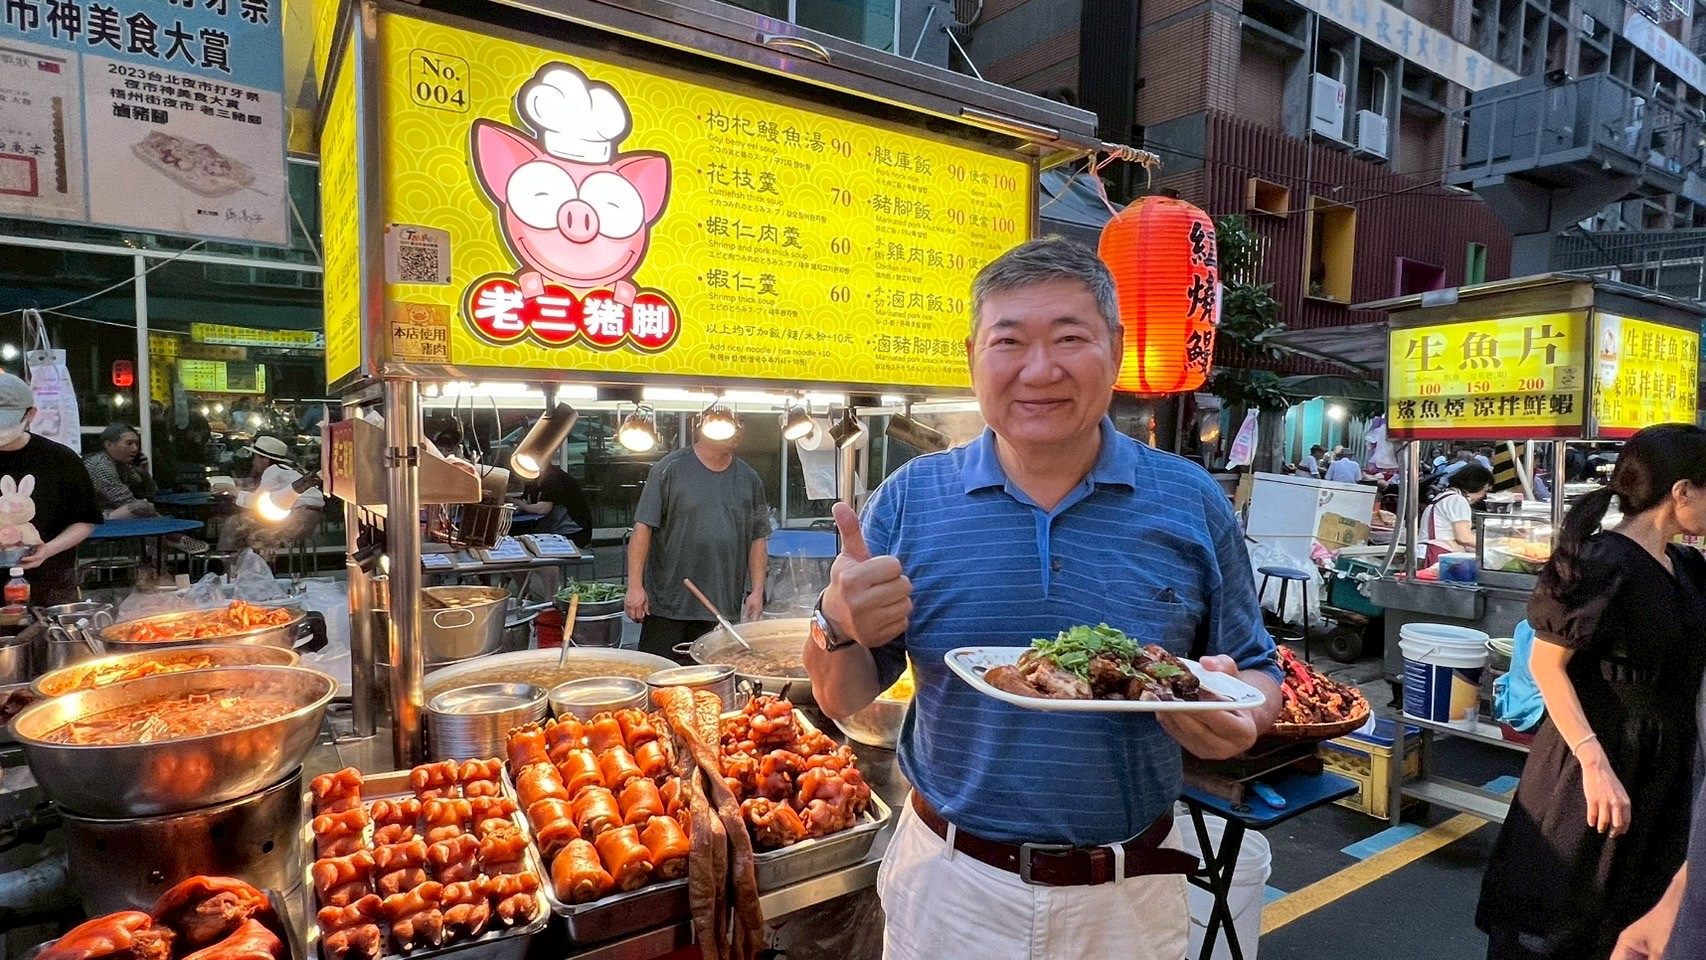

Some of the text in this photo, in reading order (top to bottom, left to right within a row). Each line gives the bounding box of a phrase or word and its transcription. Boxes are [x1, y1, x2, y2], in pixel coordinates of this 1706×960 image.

[4, 0, 231, 73] 市神美食大賞
[421, 56, 460, 81] No.
[417, 81, 465, 107] 004
[705, 108, 851, 158] 枸杞鰻魚湯 90
[708, 134, 723, 144] Goji
[725, 137, 745, 149] berry
[760, 145, 777, 155] soup
[873, 146, 932, 177] 腿庫飯
[948, 164, 965, 182] 90
[993, 174, 1016, 192] 100
[706, 162, 851, 207] 花枝羹 70
[708, 187, 745, 200] Cuttlefish
[766, 196, 784, 206] soup
[872, 193, 932, 222] 豬腳飯
[948, 208, 965, 226] 90
[991, 216, 1015, 234] 100
[706, 216, 851, 255] 蝦仁肉羹 60
[708, 240, 808, 261] Shrimp and pork thick soup
[887, 242, 945, 269] 雞肉飯
[947, 254, 964, 271] 30
[706, 268, 851, 303] 蝦仁羹 60
[708, 292, 775, 307] Shrimp thick soup
[887, 289, 964, 314] 滷肉飯 30
[394, 327, 446, 341] 本店使用
[709, 343, 726, 351] Add
[873, 333, 967, 357] 滷豬腳麵線
[1404, 324, 1566, 373] 生魚片
[1419, 378, 1545, 395] 100 150 200
[1397, 394, 1573, 420] 鯊魚煙 涼拌鮮蝦
